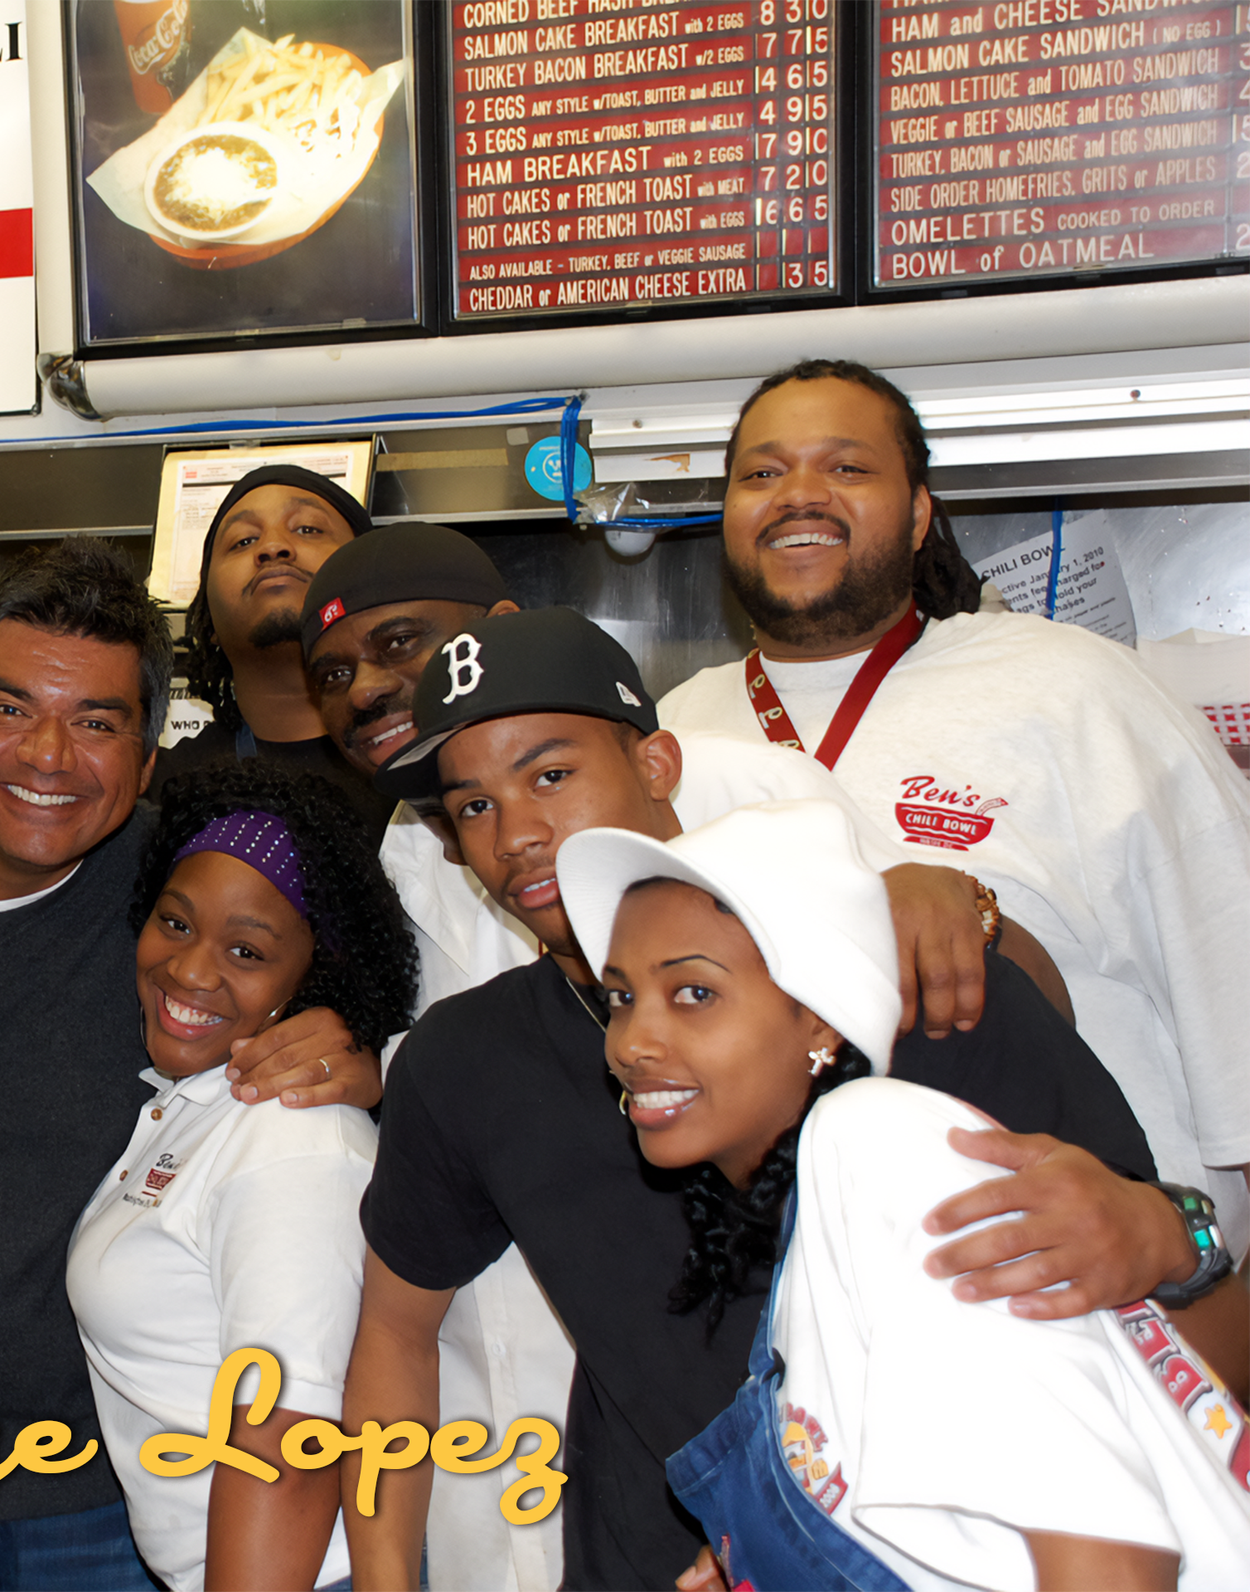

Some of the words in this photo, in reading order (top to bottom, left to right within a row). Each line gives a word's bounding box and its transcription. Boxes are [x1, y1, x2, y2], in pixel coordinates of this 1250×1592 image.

[463, 0, 529, 29] CORNED
[464, 30, 528, 60] SALMON
[535, 24, 577, 52] CAKE
[585, 11, 679, 47] BREAKFAST
[707, 16, 713, 32] 2
[718, 12, 744, 30] EGGS
[892, 13, 938, 42] HAM
[950, 7, 983, 36] and
[994, 0, 1083, 30] CHEESE
[464, 62, 527, 92] TURKEY
[534, 56, 586, 85] BACON
[594, 44, 688, 78] BREAKFAST
[718, 46, 744, 64] EGGS
[891, 43, 969, 77] SALMON
[979, 36, 1029, 67] CAKE
[1040, 21, 1144, 59] SANDWICH
[951, 72, 1020, 105] LETTUCE
[1028, 68, 1051, 96] and
[1060, 59, 1125, 91] TOMATO
[1133, 47, 1219, 83] SANDWICH
[466, 100, 476, 124] 2
[484, 94, 526, 123] EGGS
[531, 100, 552, 117] ANY
[556, 96, 589, 114] STYLE
[644, 85, 686, 105] BUTTER
[690, 84, 706, 100] and
[710, 79, 744, 98] JELLY
[891, 115, 939, 145] VEGGIE
[945, 120, 957, 139] or
[964, 108, 1000, 138] BEEF
[1006, 100, 1070, 133] SAUSAGE
[1077, 98, 1099, 125] and
[1106, 93, 1133, 122] EGG
[1141, 84, 1218, 118] SANDWICH
[466, 132, 477, 156] 3
[486, 127, 527, 154] EGGS
[532, 132, 553, 149] ANY
[557, 128, 589, 146] STYLE
[644, 118, 686, 138] BUTTER
[690, 117, 706, 133] and
[710, 112, 744, 131] JELLY
[950, 144, 993, 174] BACON
[999, 149, 1011, 168] or
[1017, 134, 1078, 166] SAUSAGE
[1084, 132, 1104, 159] and
[1111, 128, 1137, 156] EGG
[1144, 120, 1217, 152] SANDWICH
[467, 160, 512, 187] HAM
[524, 146, 651, 182] BREAKFAST
[664, 152, 688, 168] with
[694, 150, 702, 165] 2
[709, 145, 744, 164] EGGS
[891, 185, 923, 213] SIDE
[930, 180, 979, 209] ORDER
[1082, 165, 1127, 194] GRITS
[1134, 170, 1148, 189] or
[1155, 156, 1215, 186] APPLES
[467, 193, 496, 218] HOT
[503, 188, 550, 215] CAKES
[557, 193, 570, 210] or
[577, 180, 636, 208] FRENCH
[643, 174, 693, 202] TOAST
[718, 178, 744, 195] MEAT
[468, 225, 496, 250] HOT
[503, 220, 550, 246] CAKES
[558, 224, 571, 242] or
[578, 212, 637, 240] FRENCH
[644, 207, 693, 234] TOAST
[720, 212, 744, 228] EGGS
[891, 207, 1044, 246] OMELETTES
[1057, 209, 1121, 231] COOKED
[1130, 206, 1150, 224] TO
[1159, 200, 1215, 221] ORDER
[470, 264, 495, 280] ALSO
[499, 260, 553, 278] AVAILABLE
[615, 252, 640, 269] BEEF
[644, 254, 654, 267] or
[658, 247, 694, 265] VEGGIE
[699, 243, 746, 262] SAUSAGE
[893, 249, 966, 279] BOWL
[980, 245, 1004, 272] of
[1019, 233, 1154, 268] OATMEAL
[470, 285, 533, 311] CHEDDAR
[539, 289, 551, 306] or
[558, 277, 629, 305] AMERICAN
[636, 272, 690, 299] CHEESE
[698, 268, 746, 295] EXTRA
[981, 559, 1018, 579] CHILI
[1083, 546, 1104, 563] 2010
[441, 632, 484, 704] B
[171, 720, 200, 730] WHO
[906, 813, 938, 826] CHILI
[942, 819, 977, 835] BOWL
